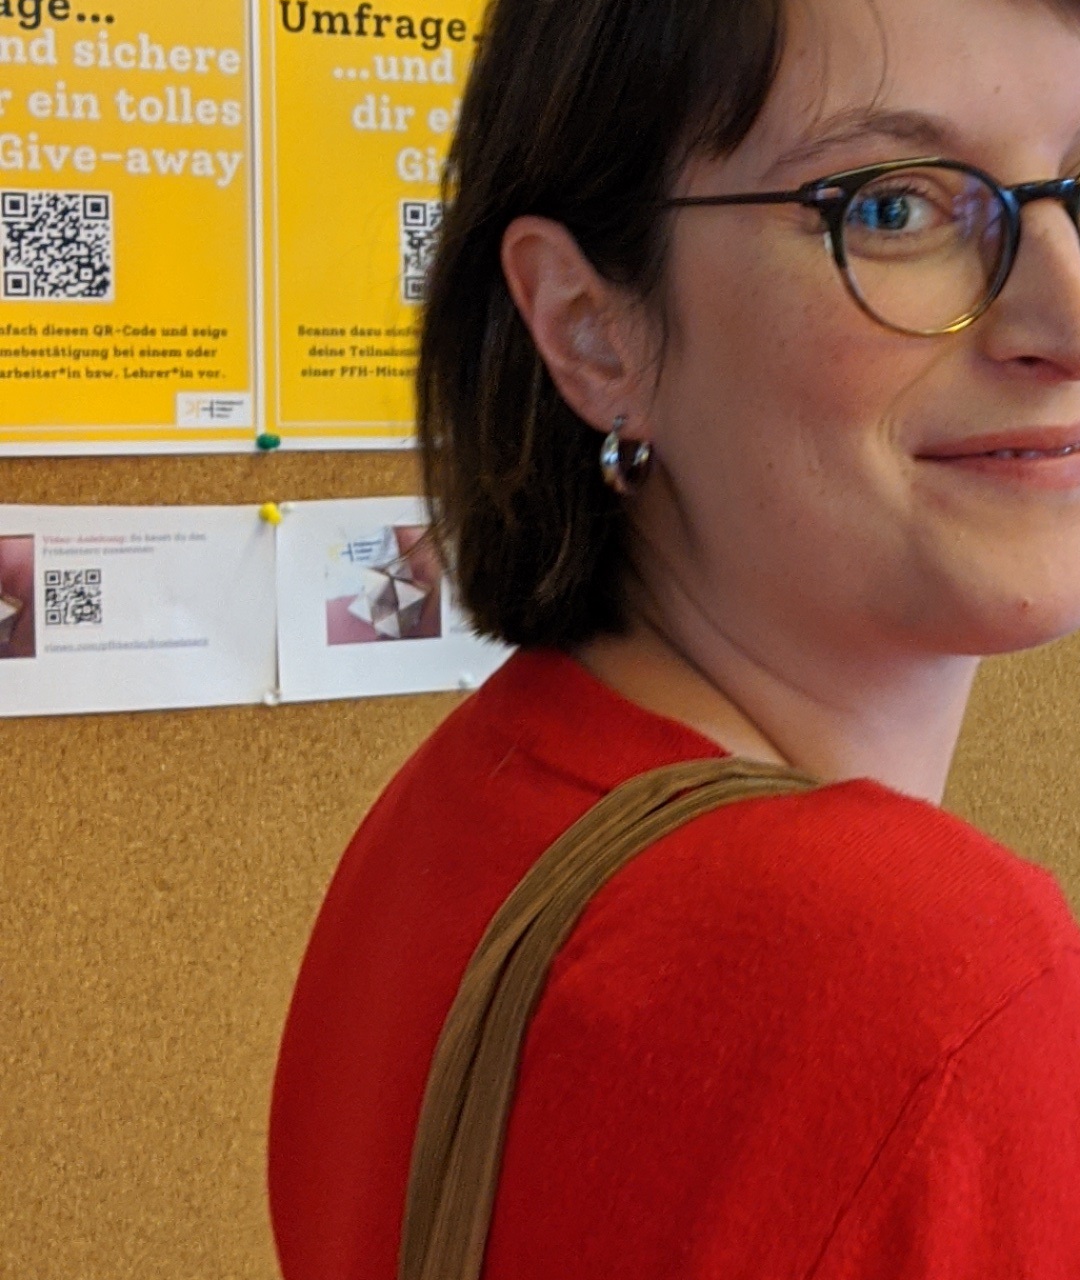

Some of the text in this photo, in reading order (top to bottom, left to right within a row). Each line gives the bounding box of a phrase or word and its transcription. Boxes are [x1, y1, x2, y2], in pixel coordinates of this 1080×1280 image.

[73, 30, 241, 75] sichere
[332, 47, 456, 85] ...und
[27, 80, 101, 120] ein
[115, 85, 242, 127] tolles
[350, 92, 416, 133] dir
[0, 131, 244, 189] Give-away
[93, 324, 156, 338] QR-Code
[161, 324, 188, 336] und
[113, 344, 134, 357] bei
[185, 345, 217, 357] oder
[308, 345, 346, 357] deine
